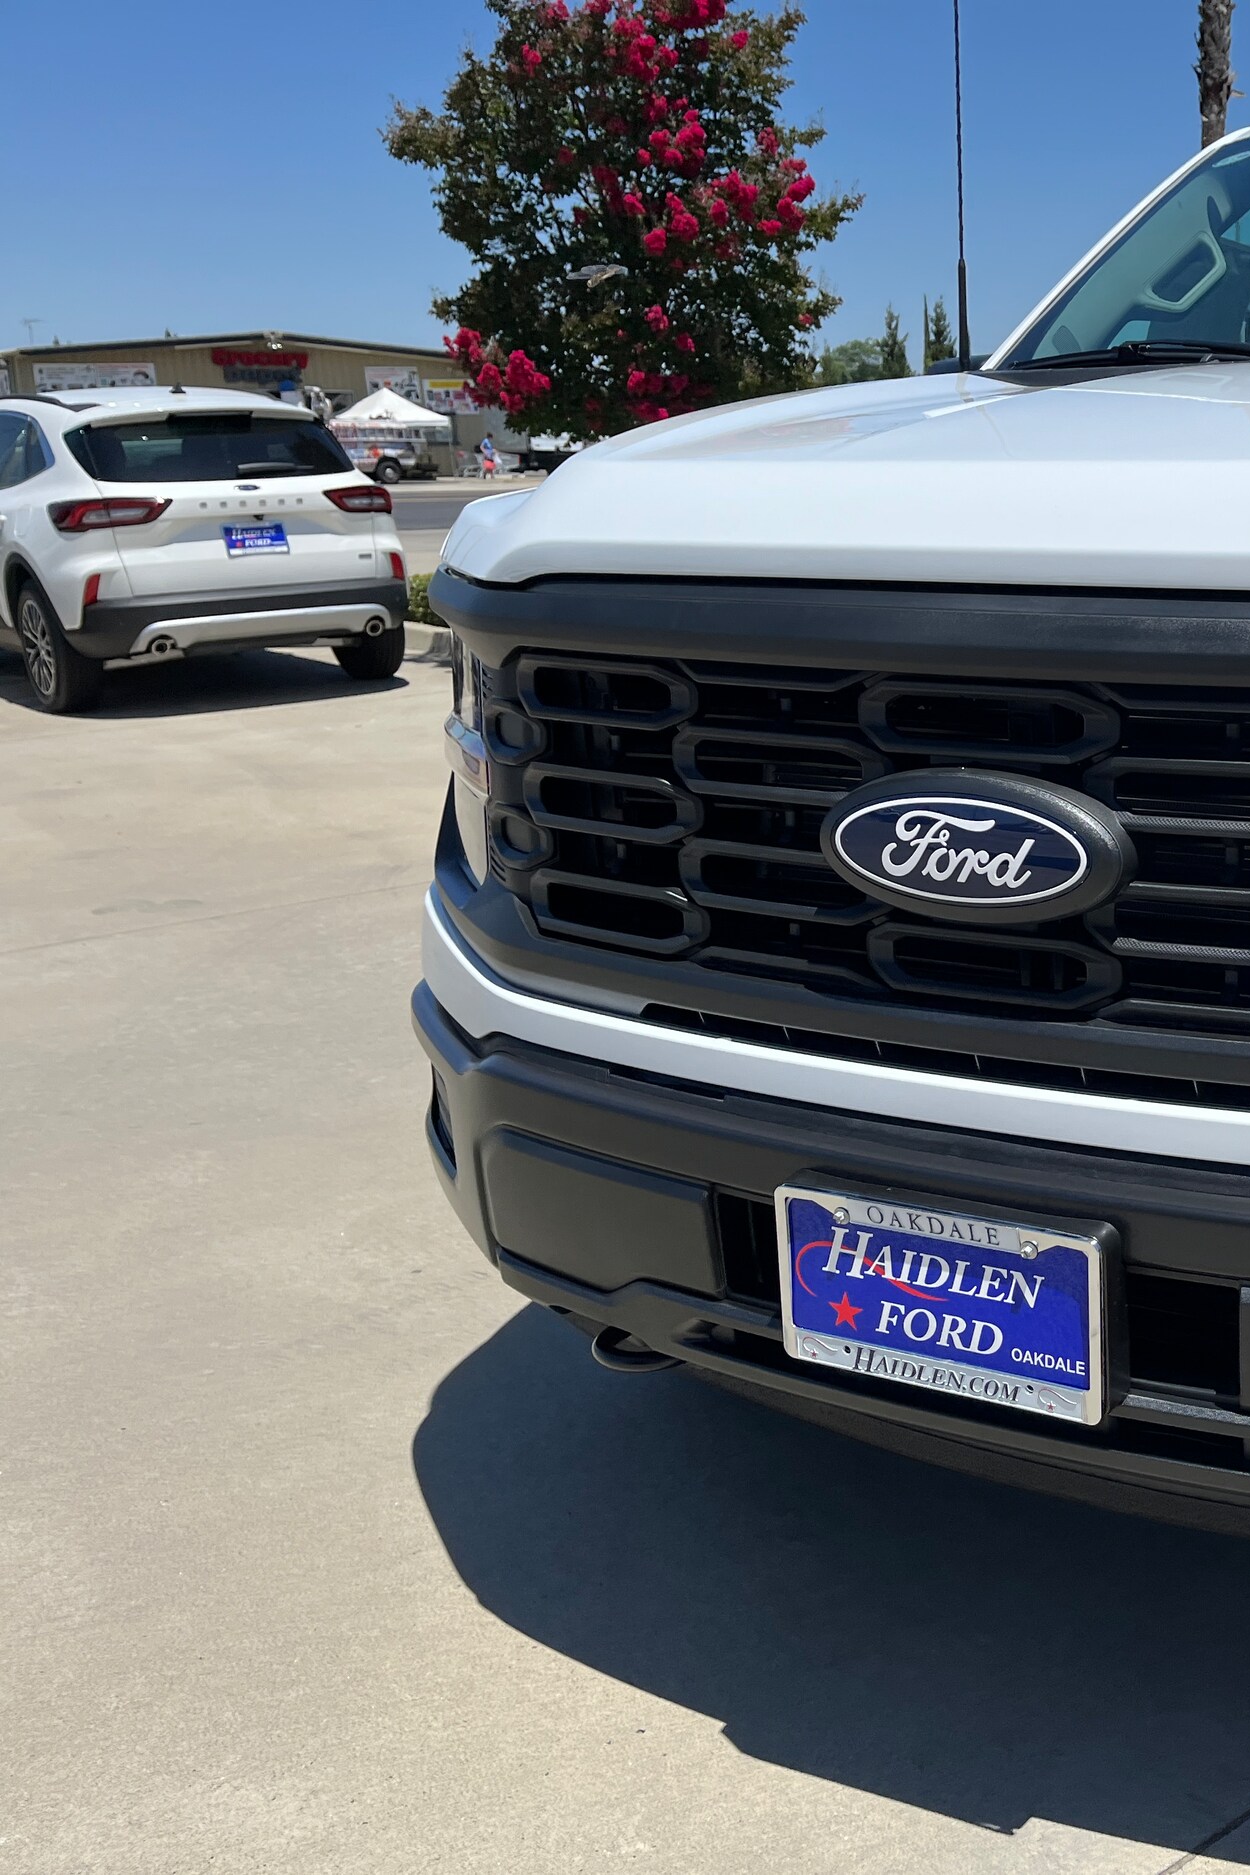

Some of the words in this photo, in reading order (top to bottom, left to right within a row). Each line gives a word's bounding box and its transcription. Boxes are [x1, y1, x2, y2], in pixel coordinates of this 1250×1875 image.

[244, 538, 272, 547] FORD
[881, 809, 1036, 889] Ford
[866, 1205, 1001, 1247] OAKDALE
[821, 1225, 1046, 1310] HAIDLEN
[874, 1299, 1005, 1356] FORD
[851, 1345, 1021, 1404] HAIDLEN.COM
[1010, 1346, 1087, 1377] OAKDALE
